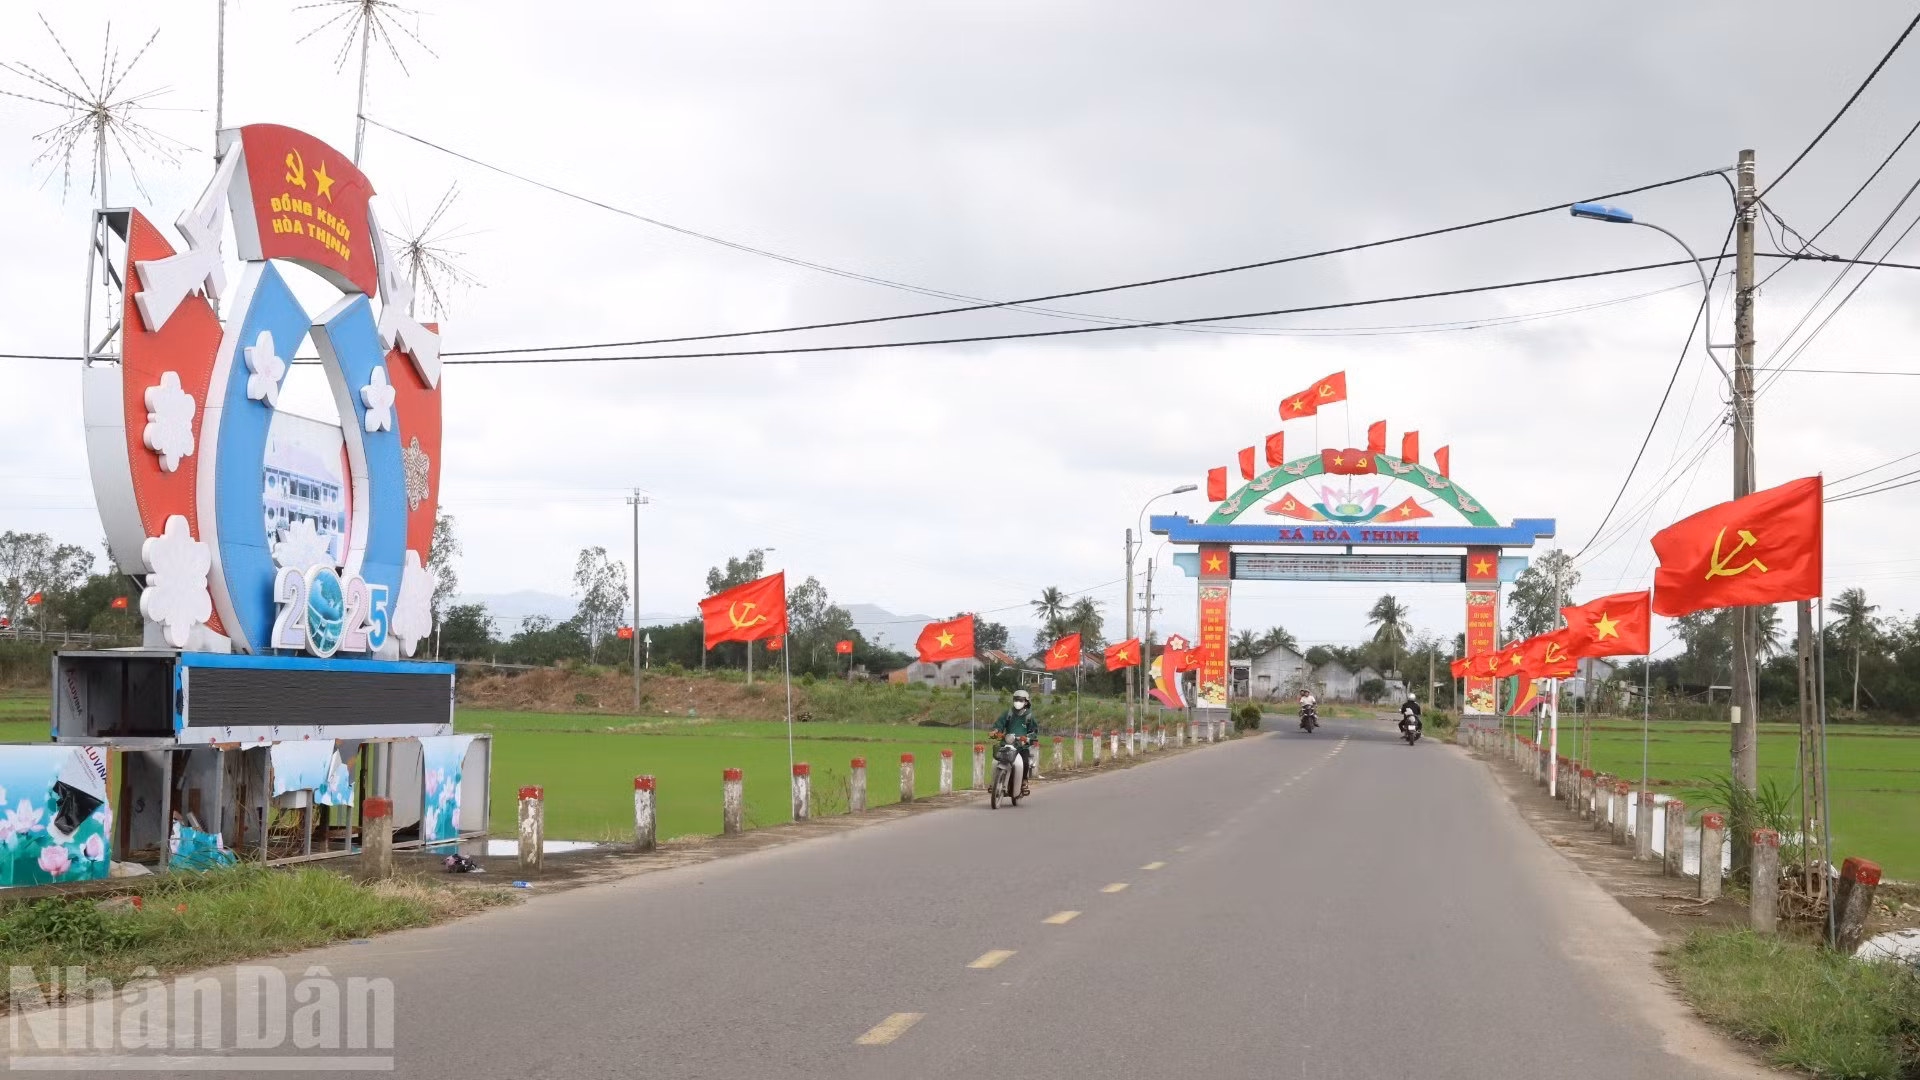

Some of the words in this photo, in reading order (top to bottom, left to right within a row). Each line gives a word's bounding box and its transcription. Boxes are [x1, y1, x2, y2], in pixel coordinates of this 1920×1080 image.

[270, 193, 313, 217] ĐỒNG
[316, 206, 351, 242] KHỞI
[272, 214, 304, 235] HÒA
[307, 223, 351, 262] THỊNH
[1312, 527, 1351, 541] HÒA
[1361, 530, 1419, 542] THỊNH
[271, 564, 388, 658] 2025
